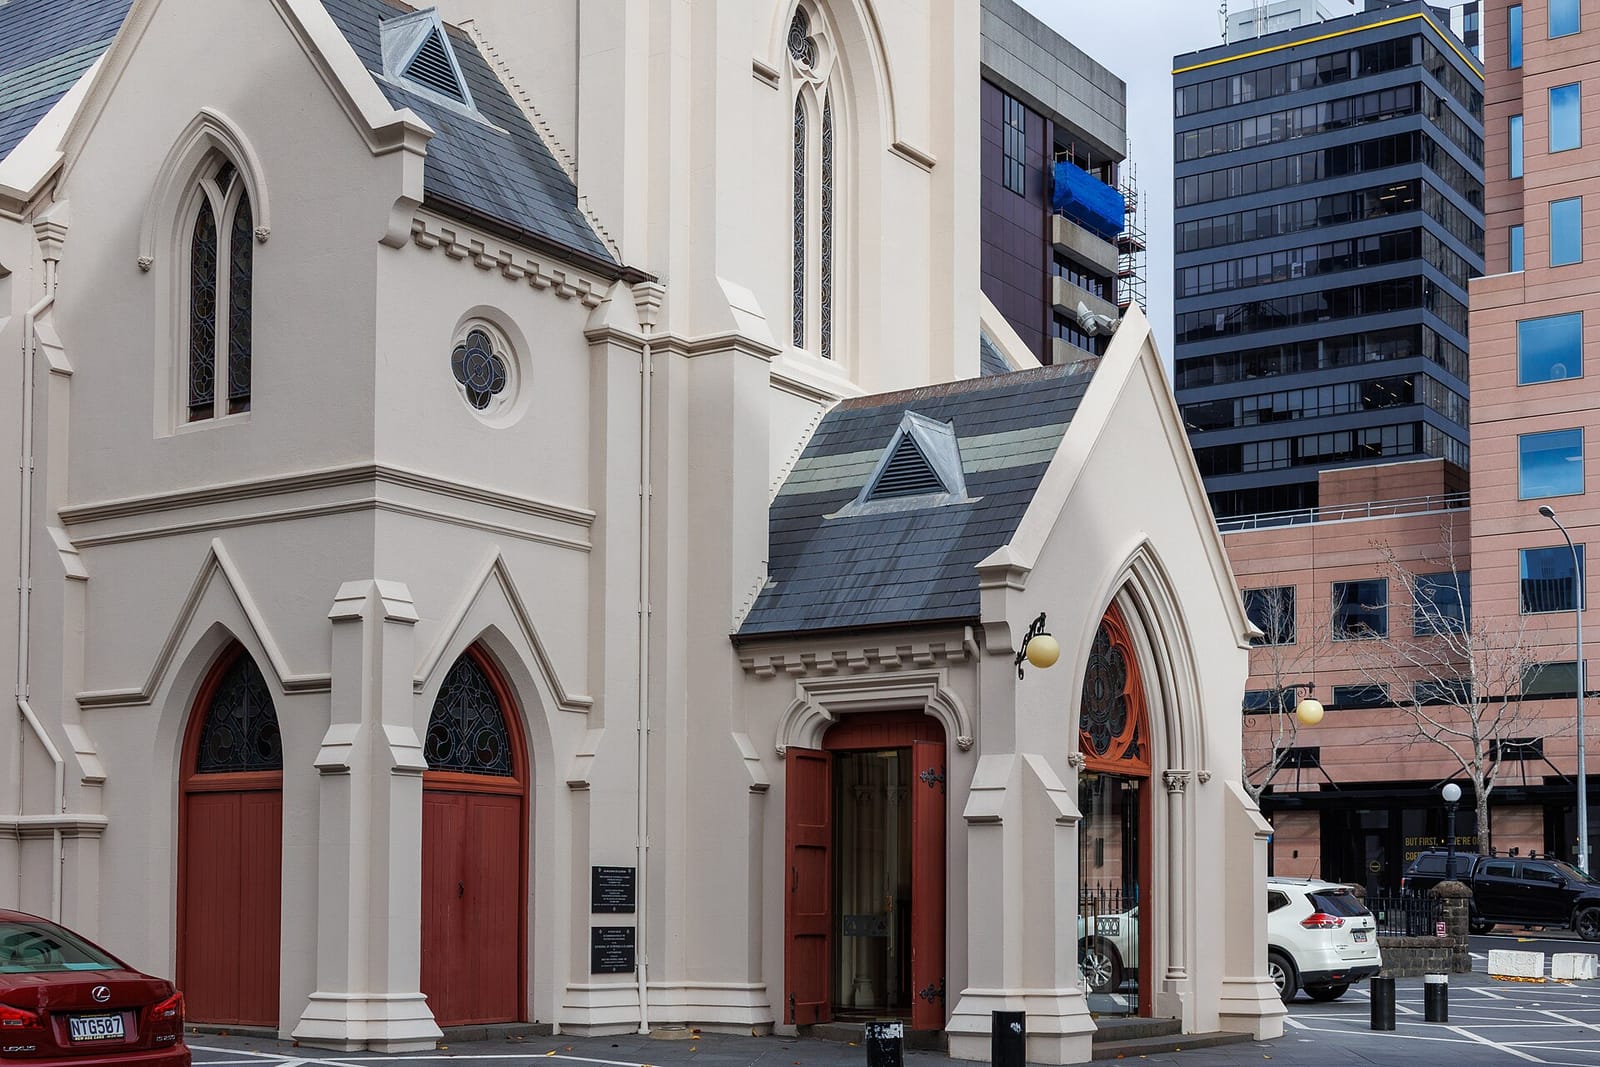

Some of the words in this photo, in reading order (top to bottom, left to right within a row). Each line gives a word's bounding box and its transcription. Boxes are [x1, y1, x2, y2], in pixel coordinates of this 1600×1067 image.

[1405, 837, 1418, 847] BUT
[1418, 836, 1439, 846] FIRST,
[71, 1018, 120, 1036] NTG507
